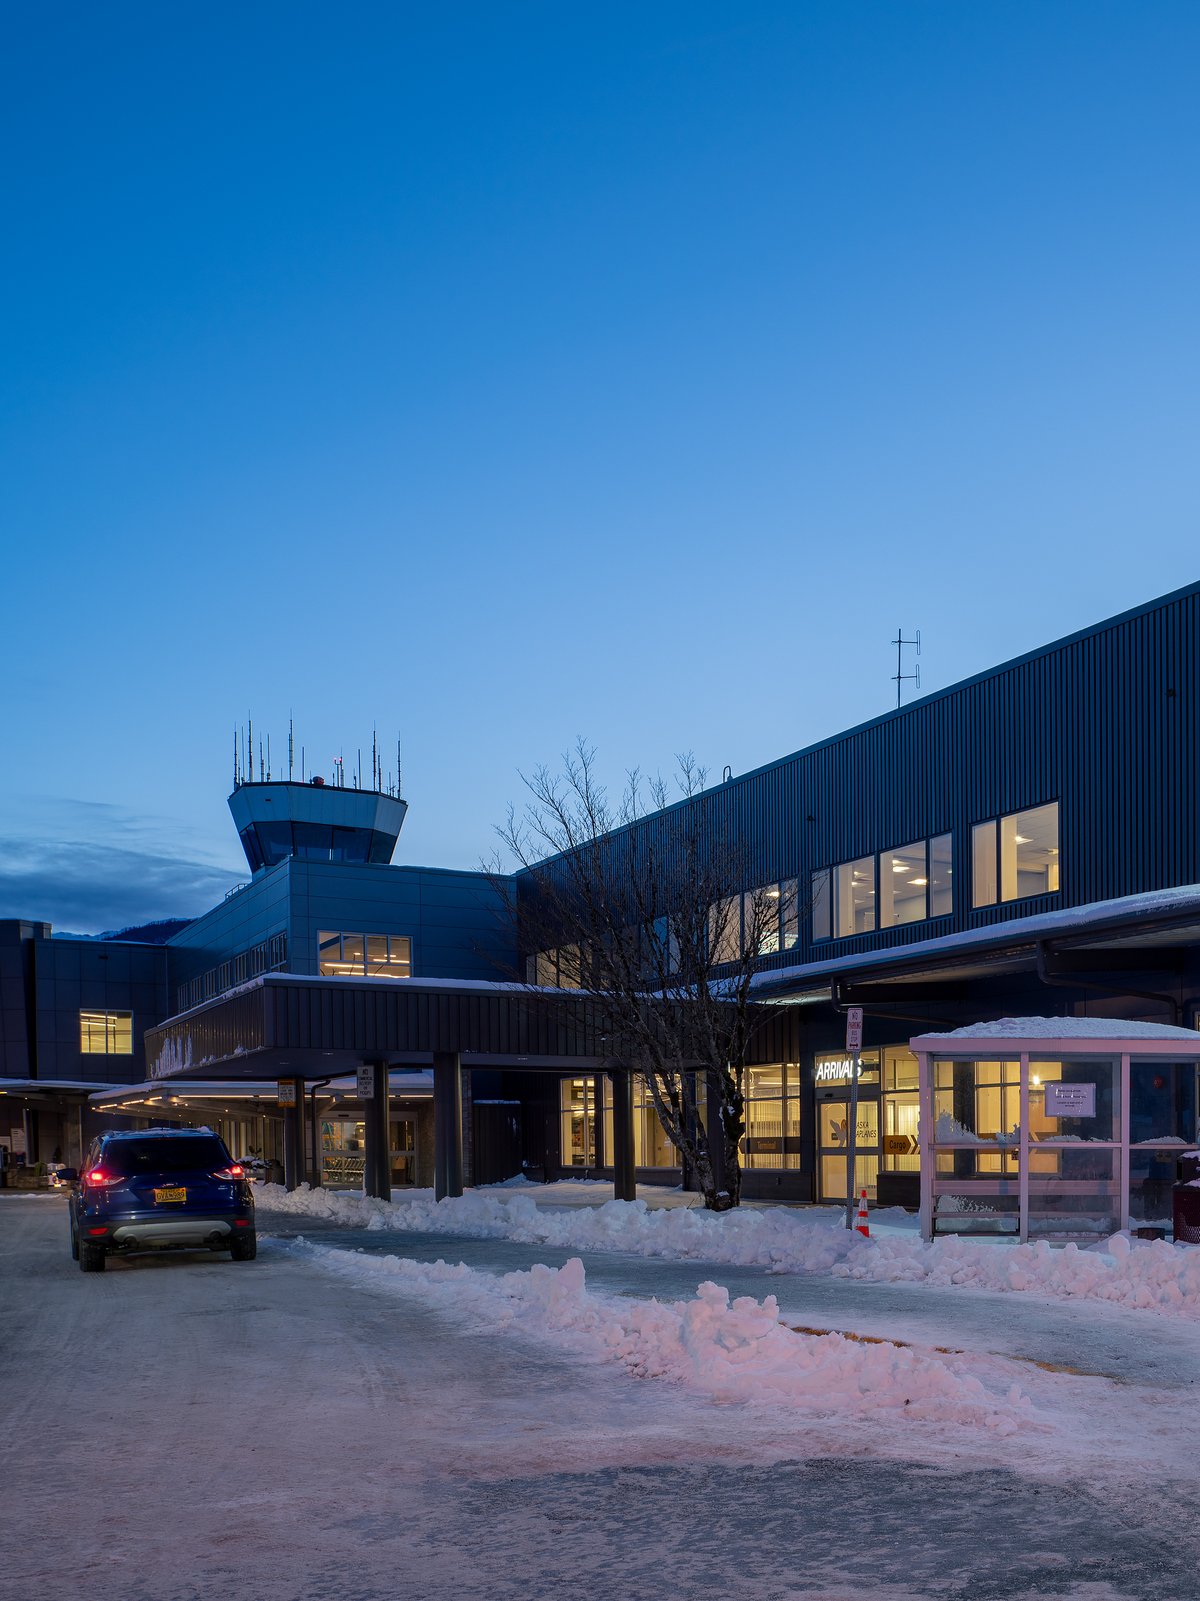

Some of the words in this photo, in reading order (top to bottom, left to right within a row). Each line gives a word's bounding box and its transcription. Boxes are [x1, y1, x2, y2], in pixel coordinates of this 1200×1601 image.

[856, 1121, 869, 1130] ASKA
[856, 1130, 877, 1139] APLANES
[889, 1139, 907, 1152] Cargo
